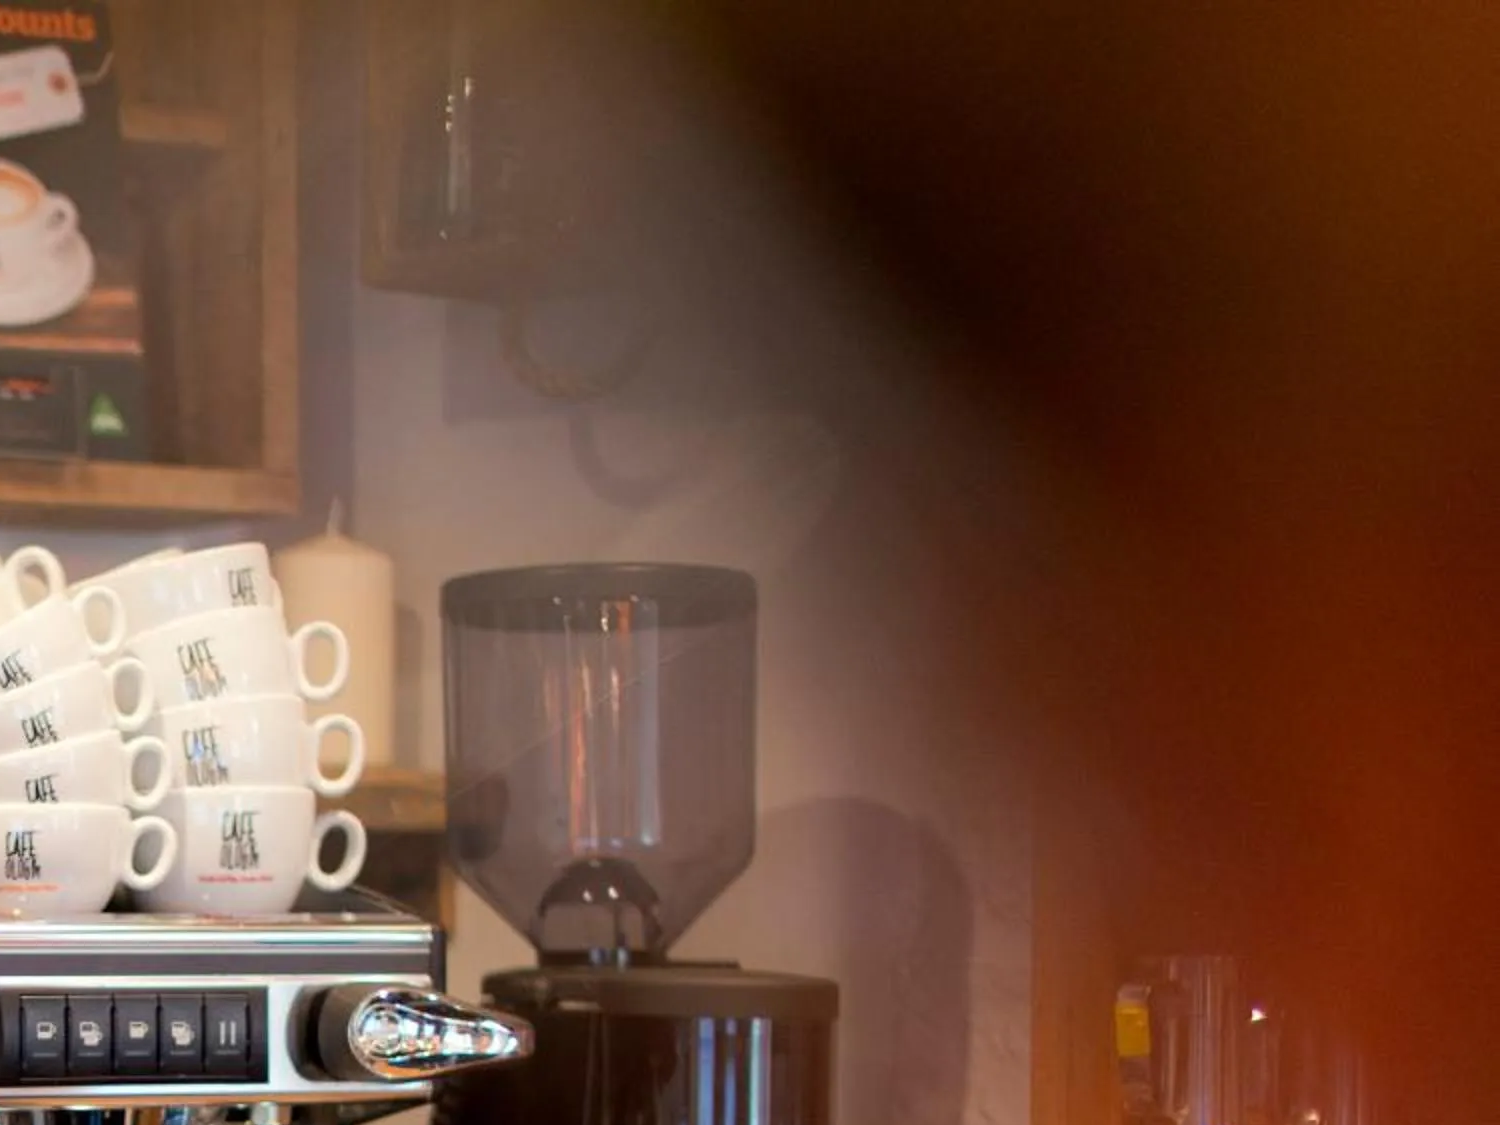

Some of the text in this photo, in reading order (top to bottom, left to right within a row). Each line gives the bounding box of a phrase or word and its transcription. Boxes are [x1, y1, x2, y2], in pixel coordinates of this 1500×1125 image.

[25, 774, 58, 804] CAFE
[222, 811, 258, 842] CAFE
[5, 831, 38, 857] CAFE
